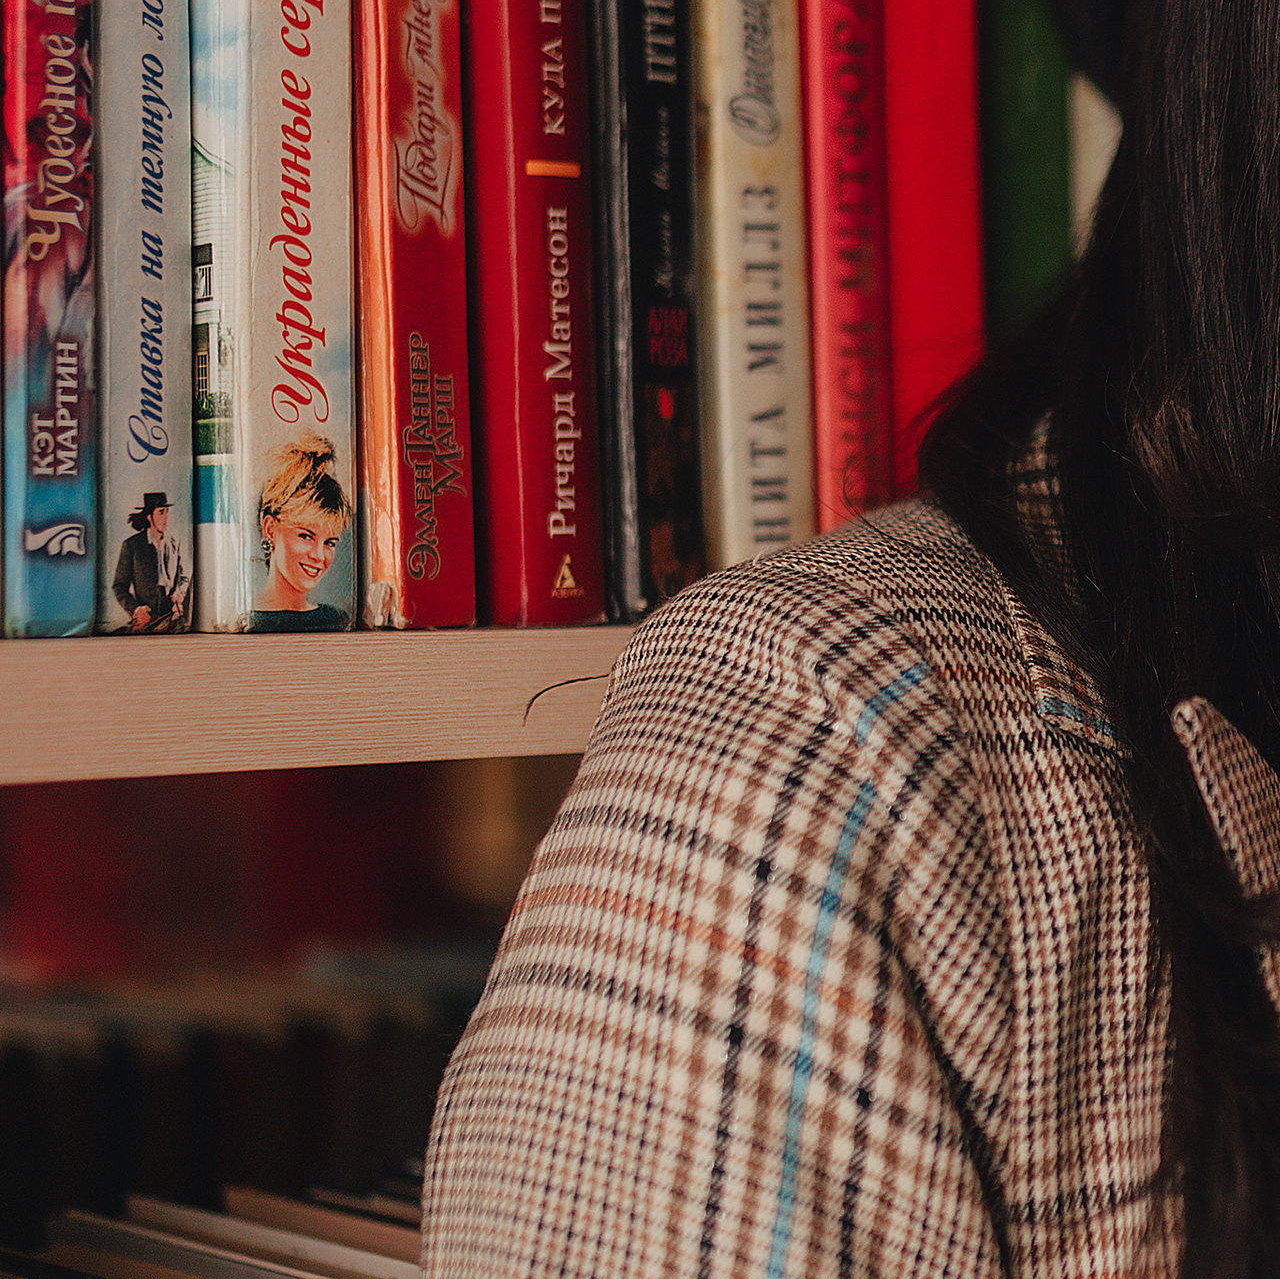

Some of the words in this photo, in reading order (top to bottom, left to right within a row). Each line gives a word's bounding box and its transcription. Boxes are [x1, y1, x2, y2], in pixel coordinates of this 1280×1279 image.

[27, 32, 87, 261] Чудесное
[140, 53, 173, 214] темную
[394, 78, 453, 236] Подари
[540, 37, 566, 137] КУДА
[141, 229, 164, 281] на
[269, 68, 330, 424] Украденные
[543, 205, 574, 383] Матесон
[743, 184, 785, 373] МИЛЛЗ
[32, 412, 56, 477] КЭТ
[55, 341, 79, 477] МАРТИН
[127, 295, 170, 464] Ставка
[546, 391, 582, 539] Ричард
[748, 406, 792, 543] НИТА
